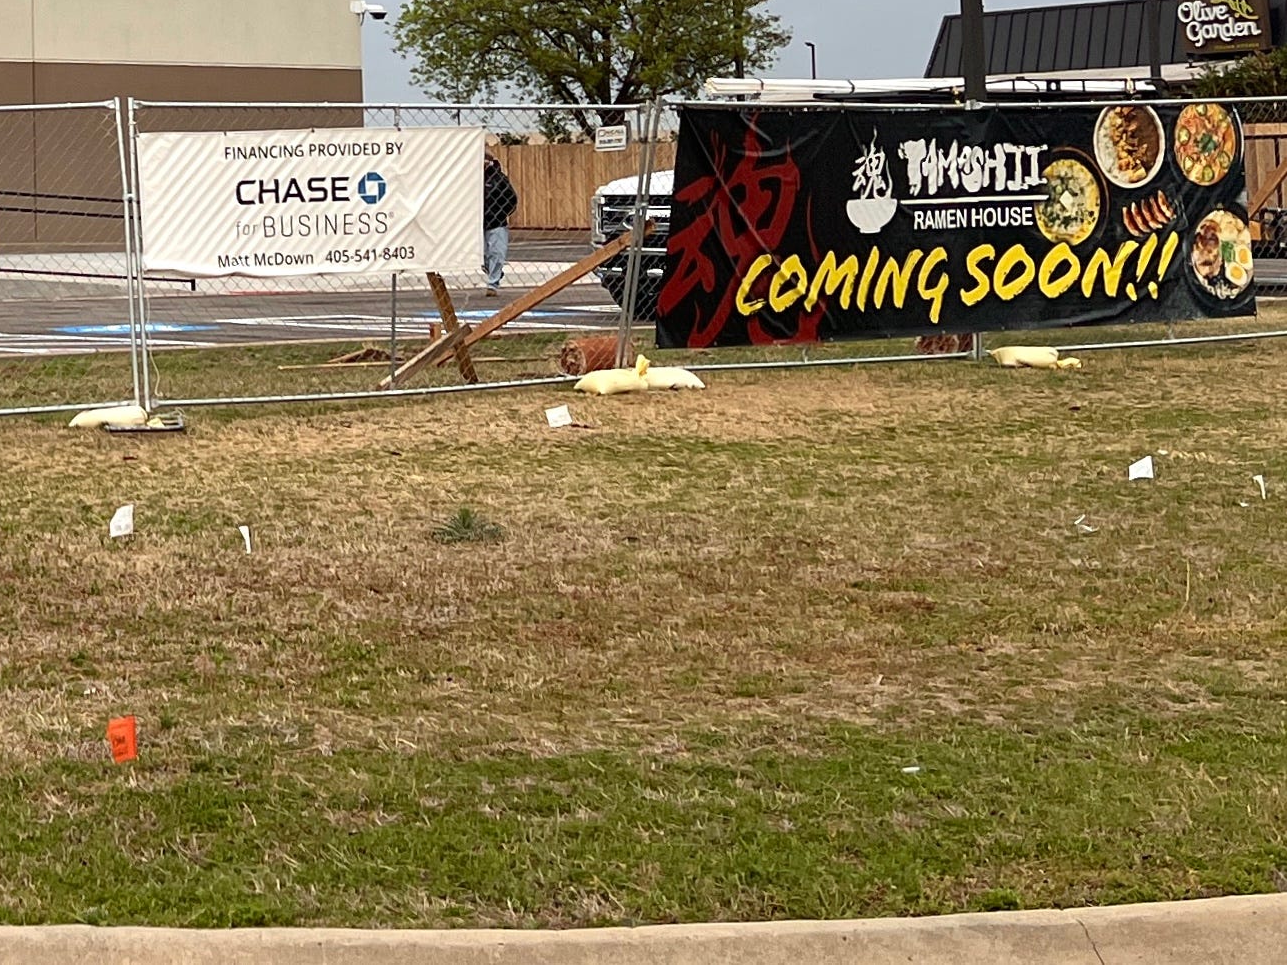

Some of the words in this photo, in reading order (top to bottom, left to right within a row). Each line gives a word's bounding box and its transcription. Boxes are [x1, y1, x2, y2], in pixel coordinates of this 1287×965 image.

[1177, 0, 1230, 23] Olive
[1186, 17, 1262, 47] Garden
[224, 144, 304, 160] FINANCING
[309, 142, 381, 157] PROVIDED
[385, 141, 404, 156] BY
[236, 176, 351, 206] CHASE
[913, 208, 968, 230] RAMEN
[971, 206, 1034, 227] HOUSE
[235, 221, 258, 239] for
[217, 254, 250, 268] Matt
[254, 252, 314, 267] McDown
[325, 246, 415, 264] 405-541-8403
[735, 244, 949, 324] COMING
[959, 231, 1178, 309] SOON!!
